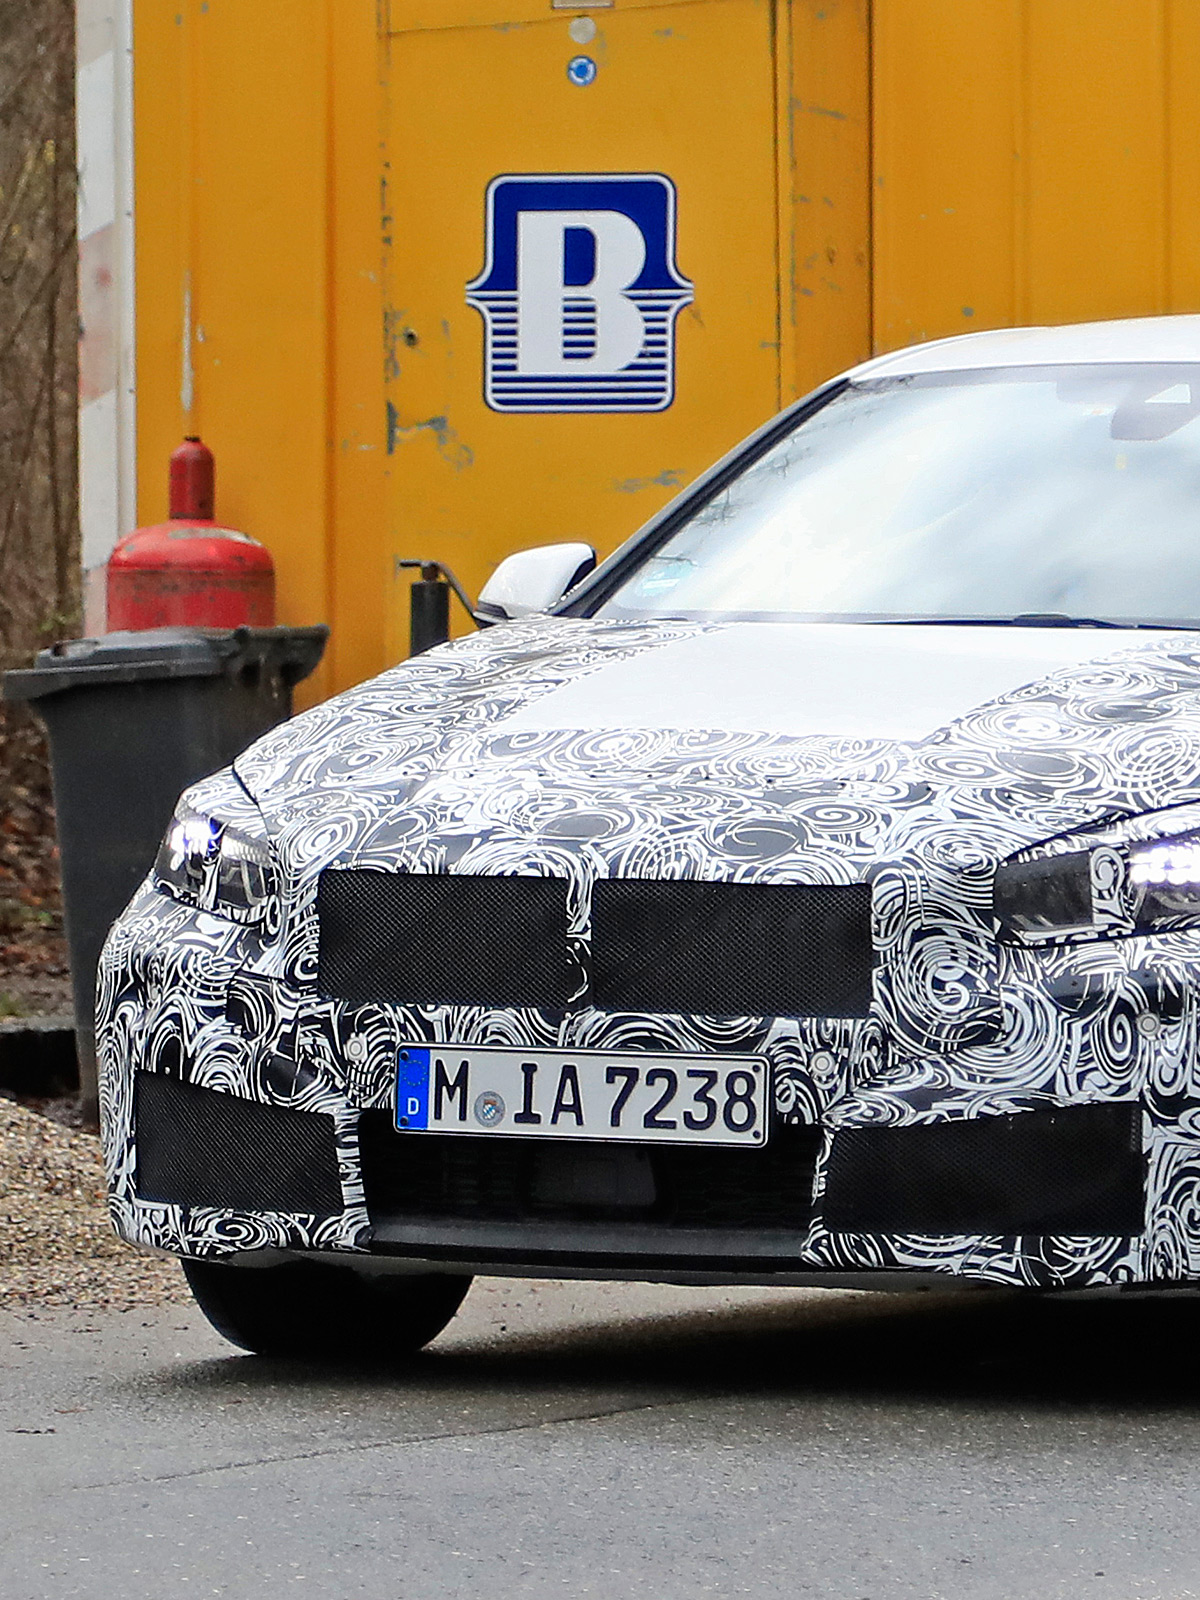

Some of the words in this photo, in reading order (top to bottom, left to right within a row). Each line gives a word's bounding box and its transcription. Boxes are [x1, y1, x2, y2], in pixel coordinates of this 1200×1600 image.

[517, 210, 647, 373] B
[407, 1097, 420, 1116] D
[434, 1058, 470, 1122] M
[513, 1062, 585, 1127] IA
[605, 1065, 758, 1133] 7238
